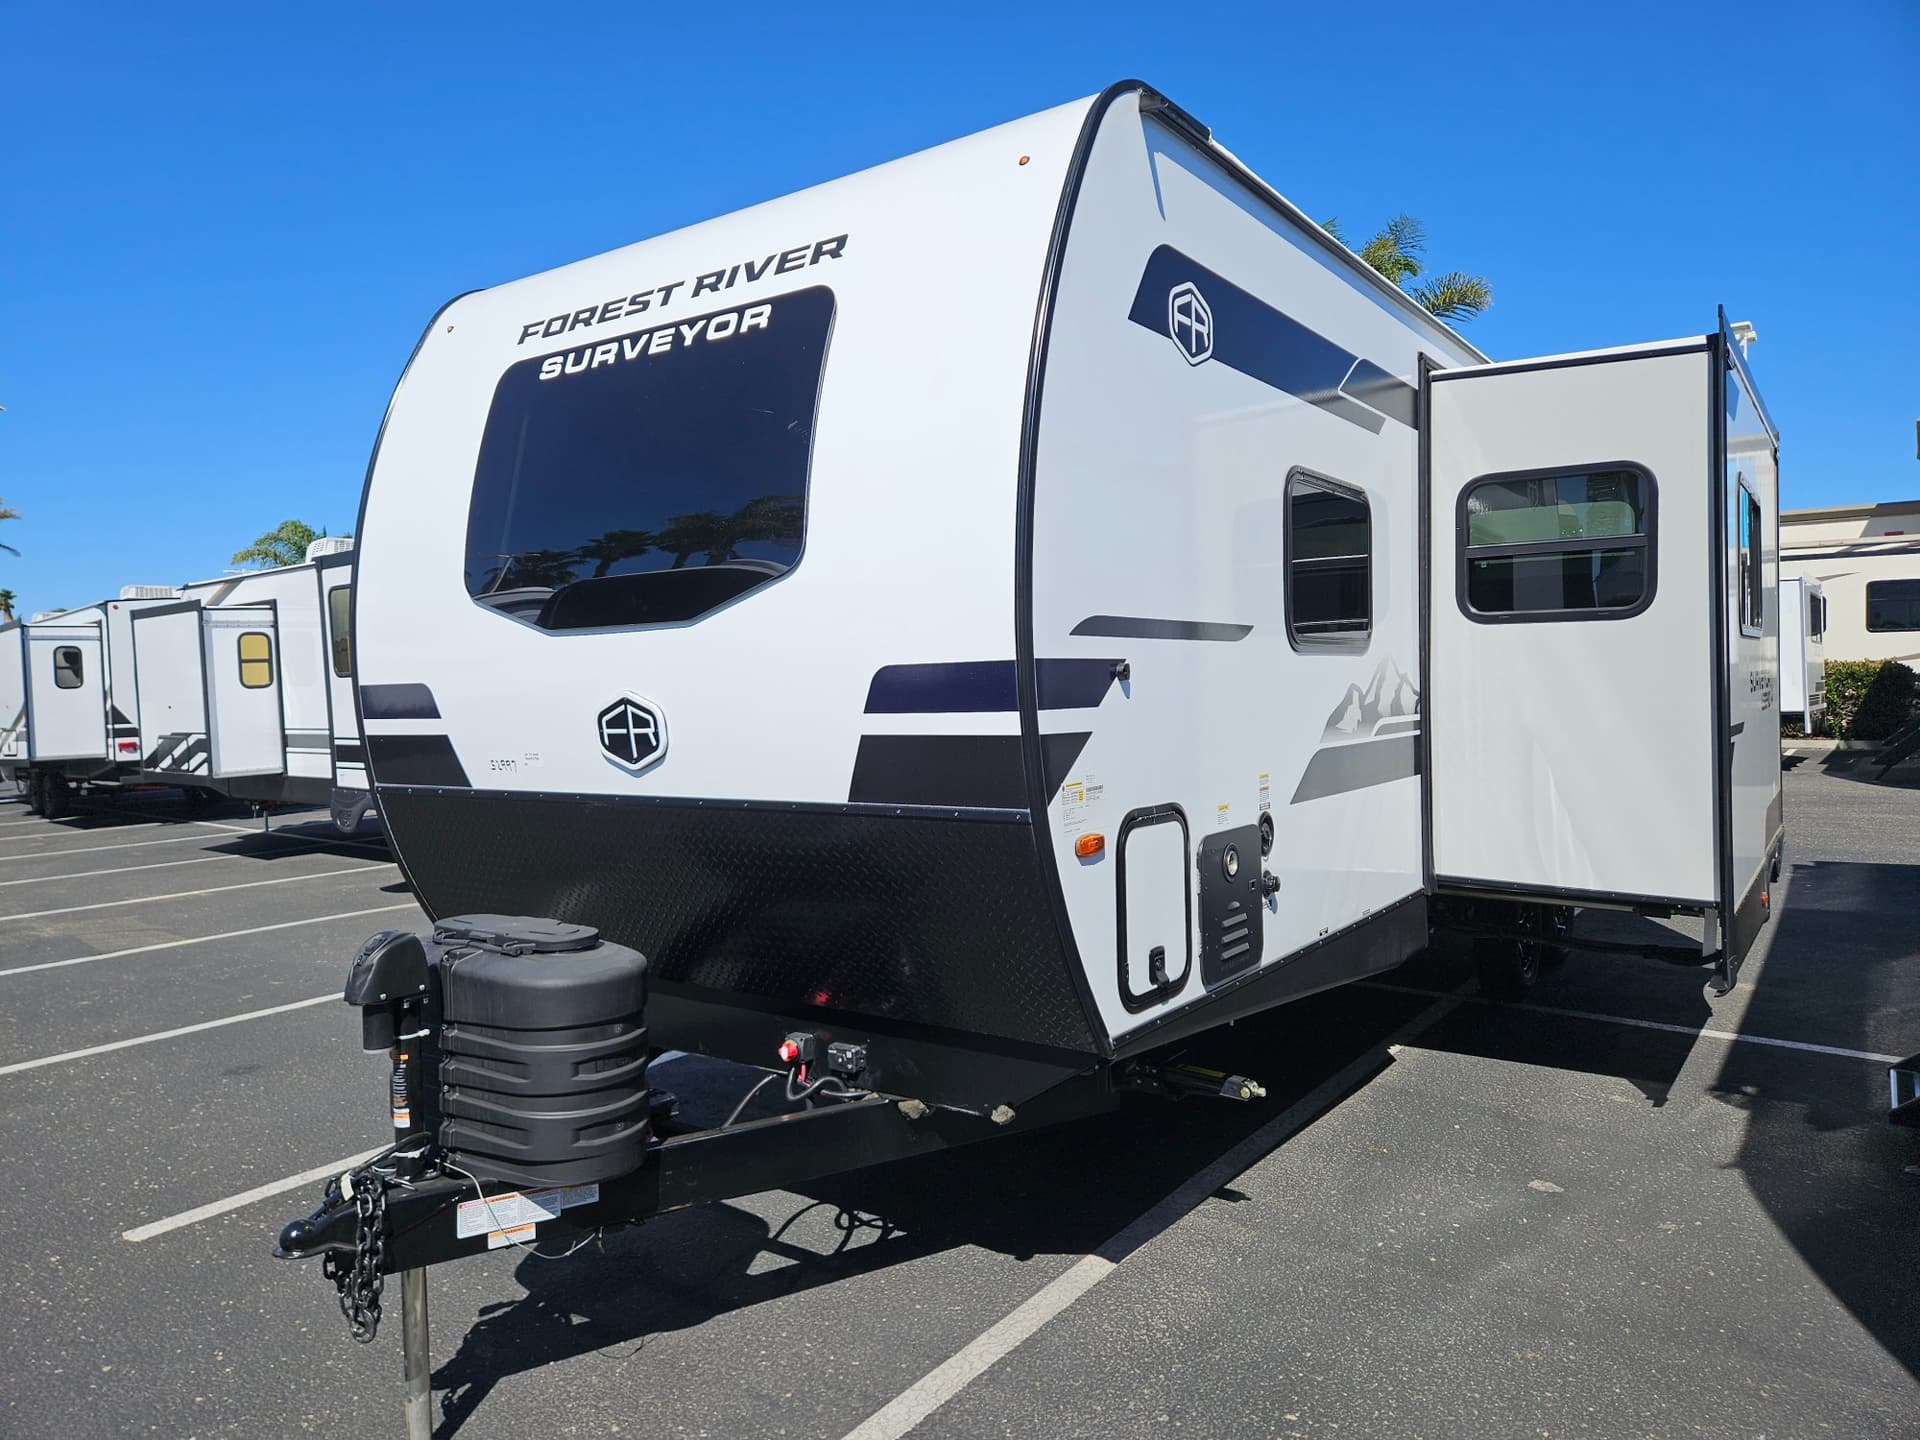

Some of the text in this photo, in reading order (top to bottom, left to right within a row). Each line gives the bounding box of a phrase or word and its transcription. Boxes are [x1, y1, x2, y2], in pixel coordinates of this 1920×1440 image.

[516, 233, 849, 345] FOREST RIVER
[538, 303, 773, 381] SURVEYOR
